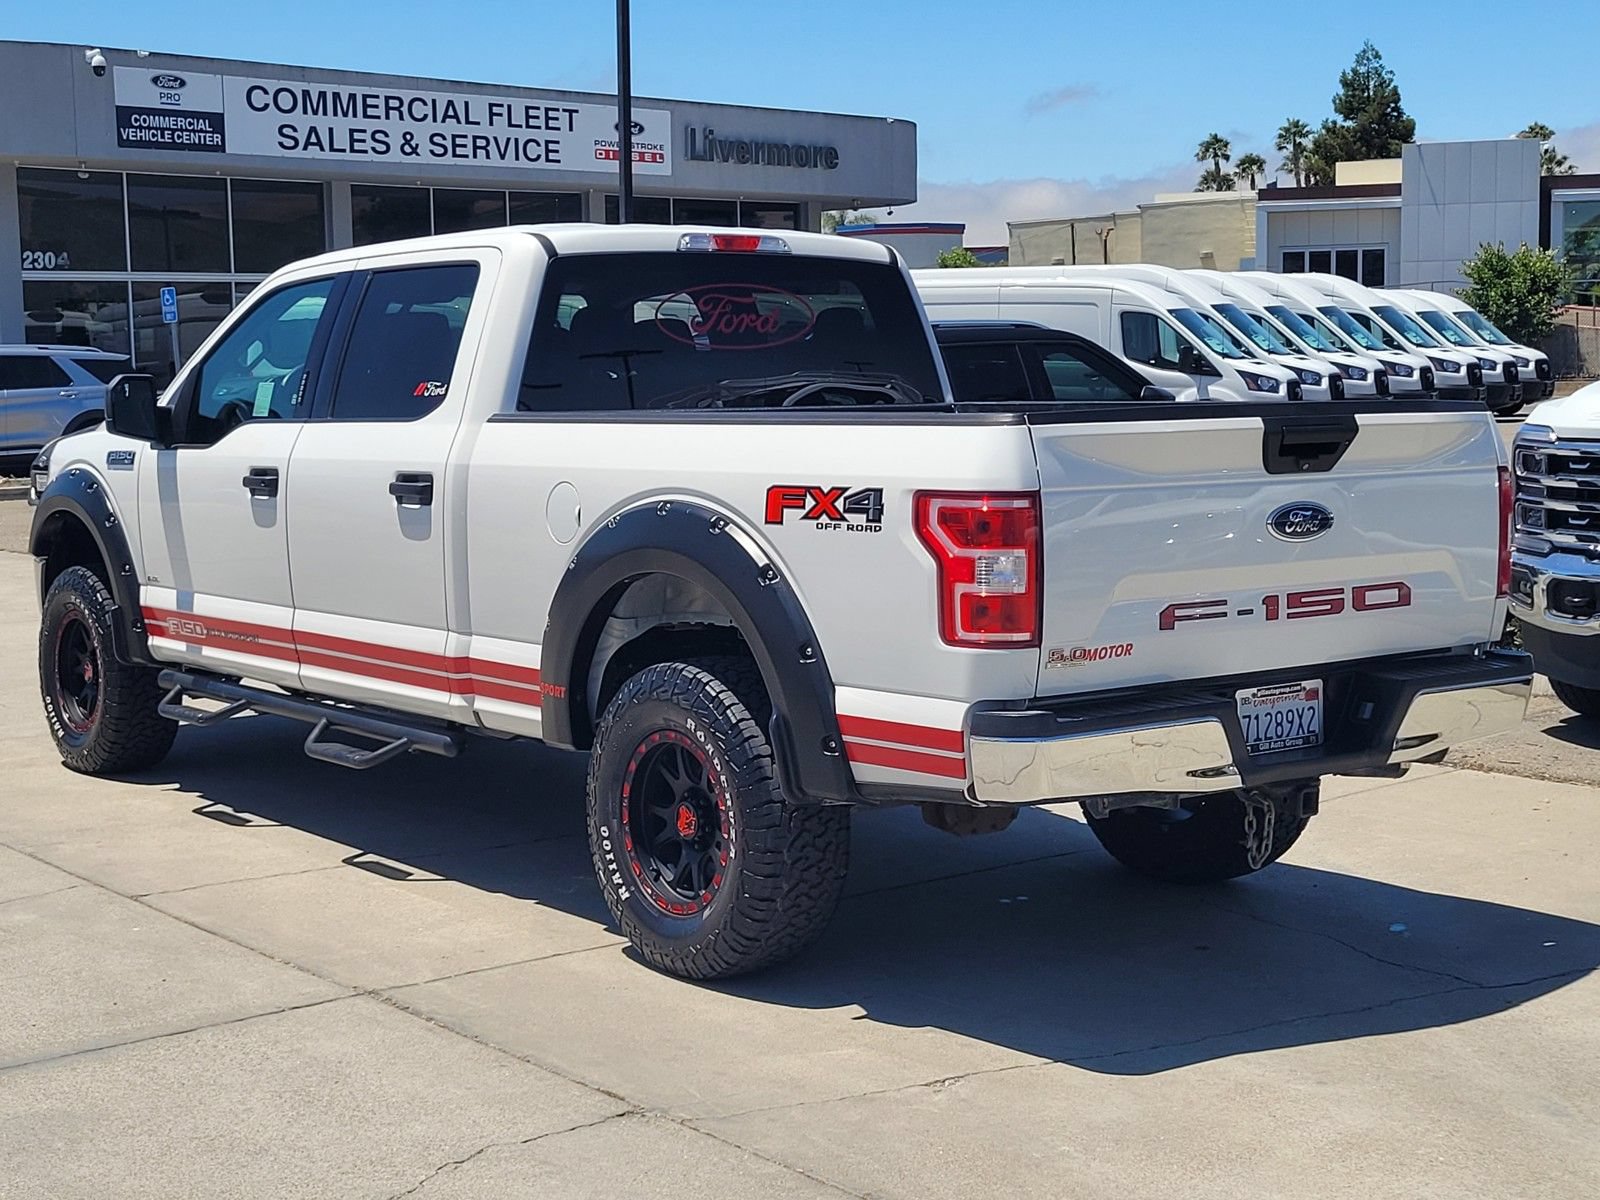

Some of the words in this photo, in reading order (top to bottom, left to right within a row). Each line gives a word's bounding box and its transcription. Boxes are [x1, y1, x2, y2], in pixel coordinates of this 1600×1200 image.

[157, 75, 181, 88] Ford
[159, 92, 181, 102] PRO
[246, 85, 480, 126] COMMERCIAL
[488, 102, 579, 132] FLEET
[131, 114, 213, 131] COMMERCIAL
[120, 128, 172, 142] VEHICLE
[174, 131, 222, 145] CENTER
[277, 124, 391, 155] SALES
[400, 131, 420, 157] &
[429, 132, 561, 164] SERVICE
[594, 140, 664, 151] POWESTROKE
[685, 126, 840, 170] Livermore
[596, 150, 664, 162] DISEL
[691, 293, 781, 334] Ford
[424, 381, 448, 397] Ford
[764, 485, 884, 525] FX4
[815, 522, 842, 531] OFF
[846, 524, 882, 533] ROAD
[1159, 581, 1412, 631] F-150
[1086, 643, 1133, 662] MOTOR
[540, 682, 566, 699] SPORT
[1242, 706, 1316, 743] 71289X2
[1259, 742, 1270, 750] Gill
[1271, 740, 1284, 748] Auto
[1285, 739, 1303, 747] Group
